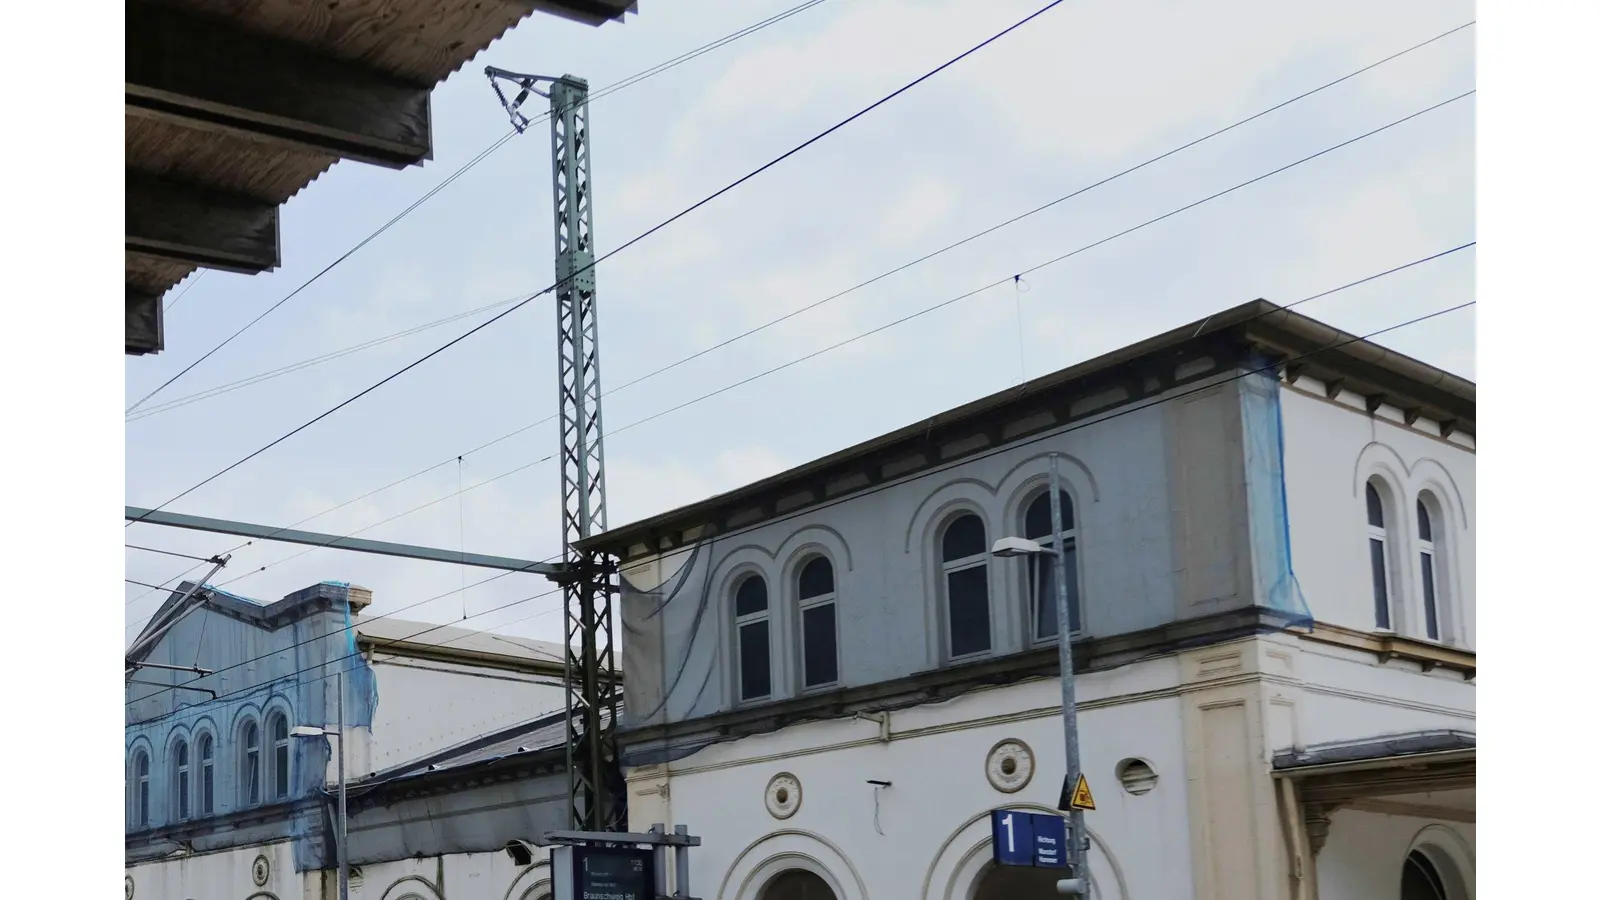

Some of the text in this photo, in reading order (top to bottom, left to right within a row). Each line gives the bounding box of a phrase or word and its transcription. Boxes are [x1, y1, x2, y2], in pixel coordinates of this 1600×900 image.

[1002, 814, 1014, 852] 1
[583, 857, 588, 871] 1
[584, 891, 624, 900] Braunschweig
